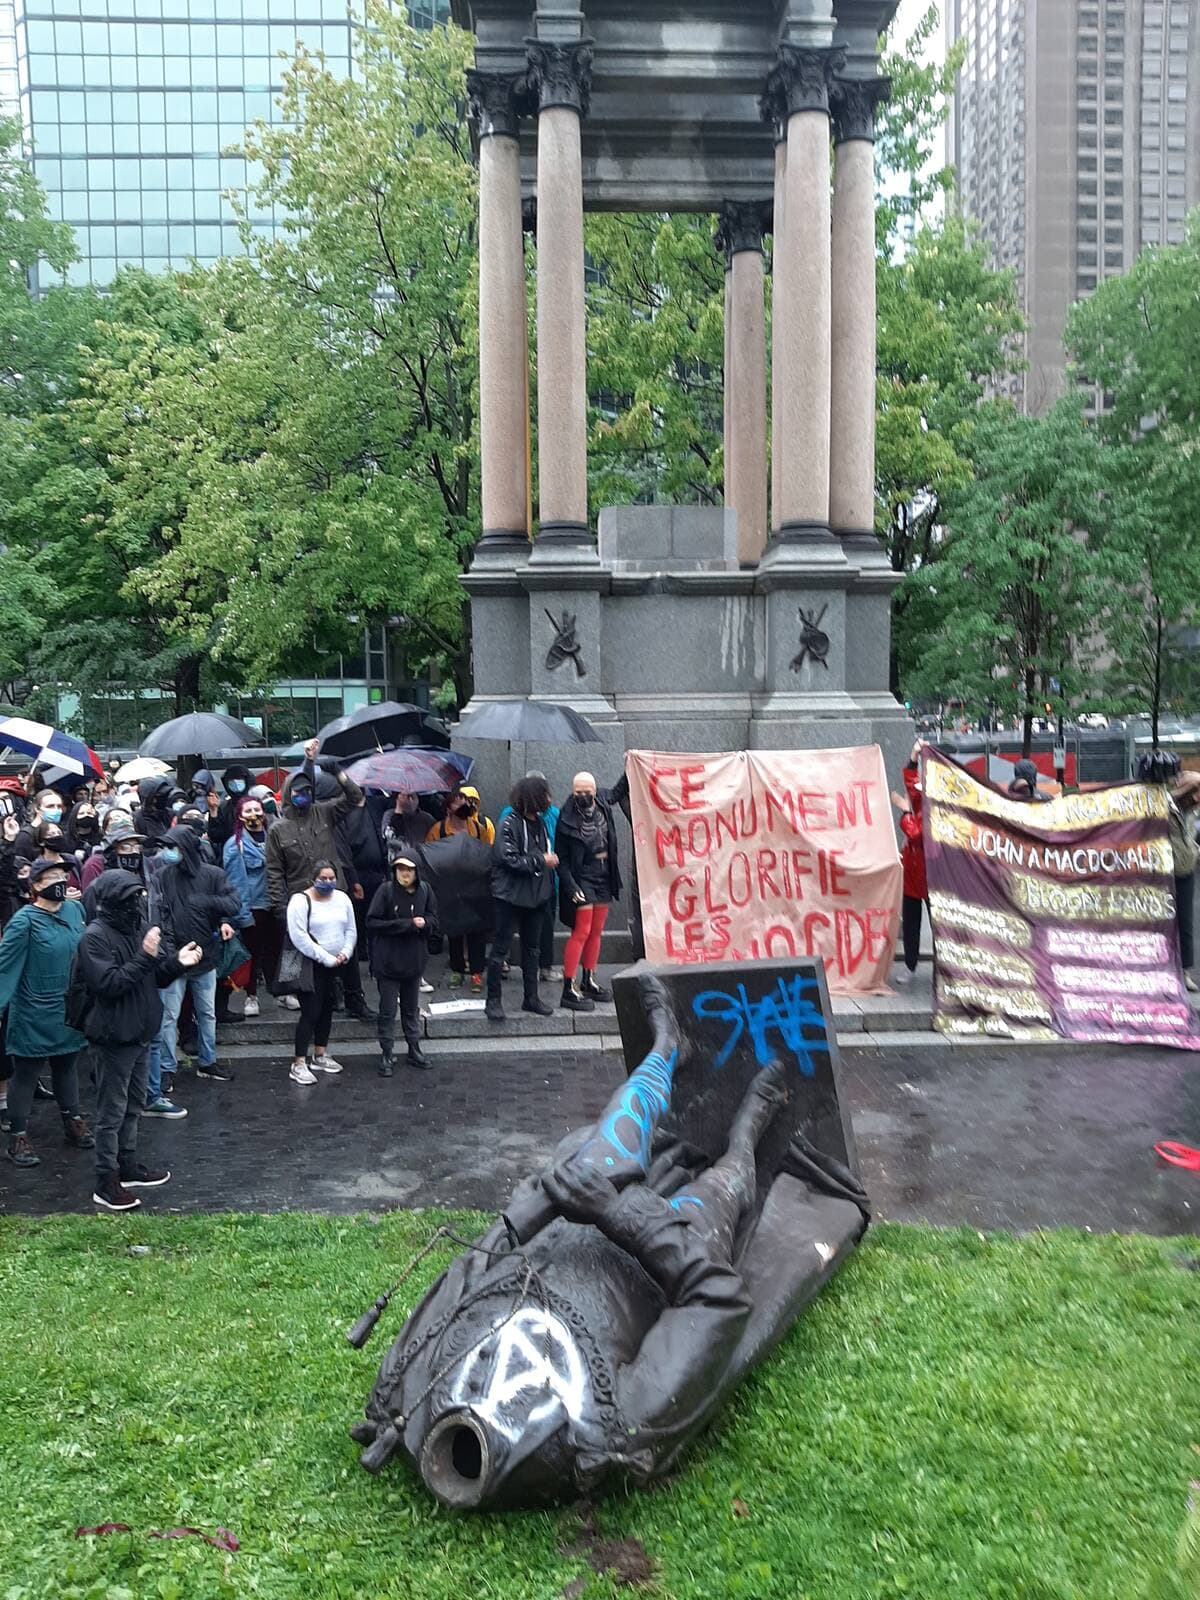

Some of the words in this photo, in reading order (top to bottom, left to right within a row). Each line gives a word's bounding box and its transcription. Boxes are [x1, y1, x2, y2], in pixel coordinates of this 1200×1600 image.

[649, 765, 708, 814] CE
[655, 780, 879, 869] MONUMENT
[970, 827, 1024, 871] JOHN
[1028, 846, 1042, 869] A
[1044, 843, 1162, 875] MACDONALD
[668, 849, 852, 922] GLORIFIE
[665, 915, 732, 957] LES
